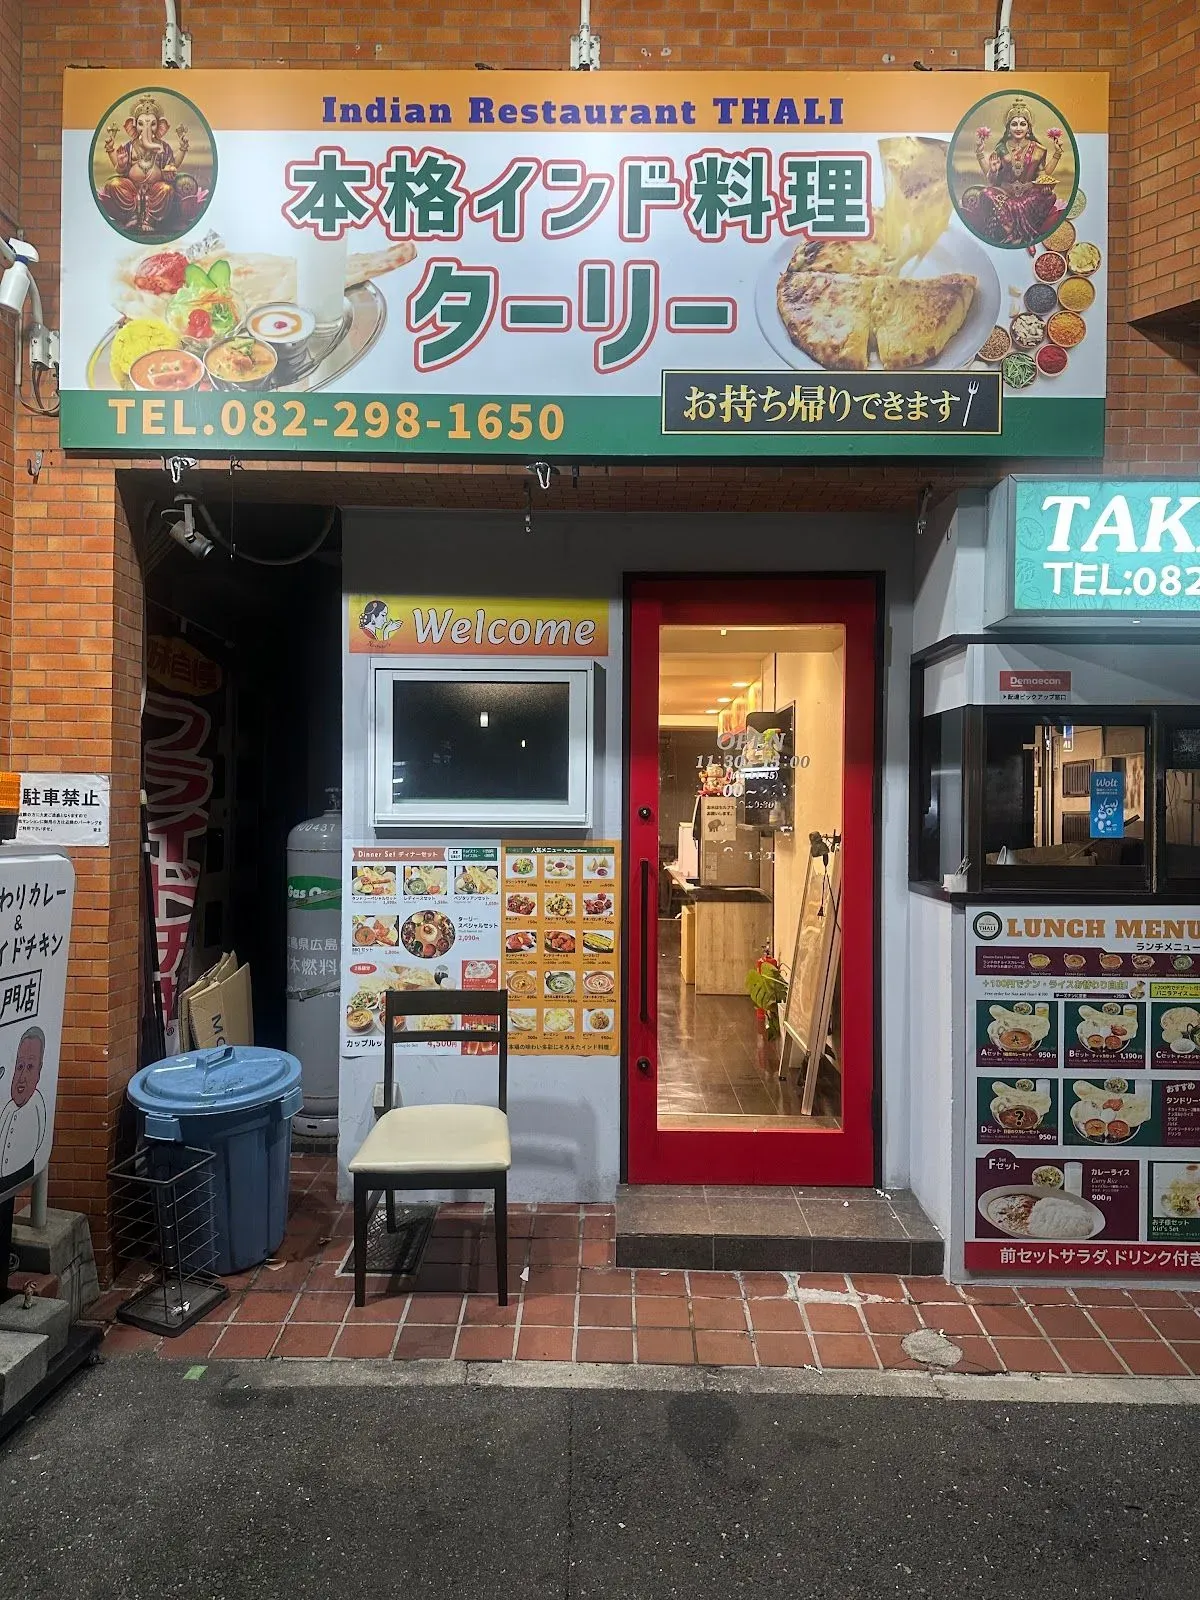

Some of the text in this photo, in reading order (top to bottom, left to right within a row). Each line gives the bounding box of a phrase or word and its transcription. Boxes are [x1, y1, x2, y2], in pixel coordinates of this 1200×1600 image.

[323, 96, 844, 125] Indian Restaurant THALI
[282, 146, 873, 242] 本格インド料理
[406, 257, 737, 374] ターリー
[683, 382, 961, 425] お持ち帰りできます
[108, 397, 566, 440] TEL.082-298-1650
[1042, 494, 1200, 553] TAK
[412, 608, 597, 646] Welcome
[1010, 676, 1061, 685] Demaecan
[1096, 778, 1118, 787] Wolt
[22, 788, 100, 807] 駐車禁止
[358, 850, 439, 858] Dinner Set ディナーセット
[14, 914, 23, 931] &
[1006, 918, 1200, 940] LUNCH MENU
[1136, 942, 1200, 951] ランチメニュー
[287, 955, 338, 976] 本燃料
[981, 1048, 1001, 1056] Aセット
[1069, 1049, 1089, 1058] Bセット
[1156, 1050, 1176, 1059] Cセット
[1166, 1082, 1195, 1093] おすすめ
[988, 1158, 1020, 1170] Fセット
[1091, 1168, 1130, 1176] カレーライス
[1000, 1246, 1200, 1267] 前セットサラダ、ドリンク付き
